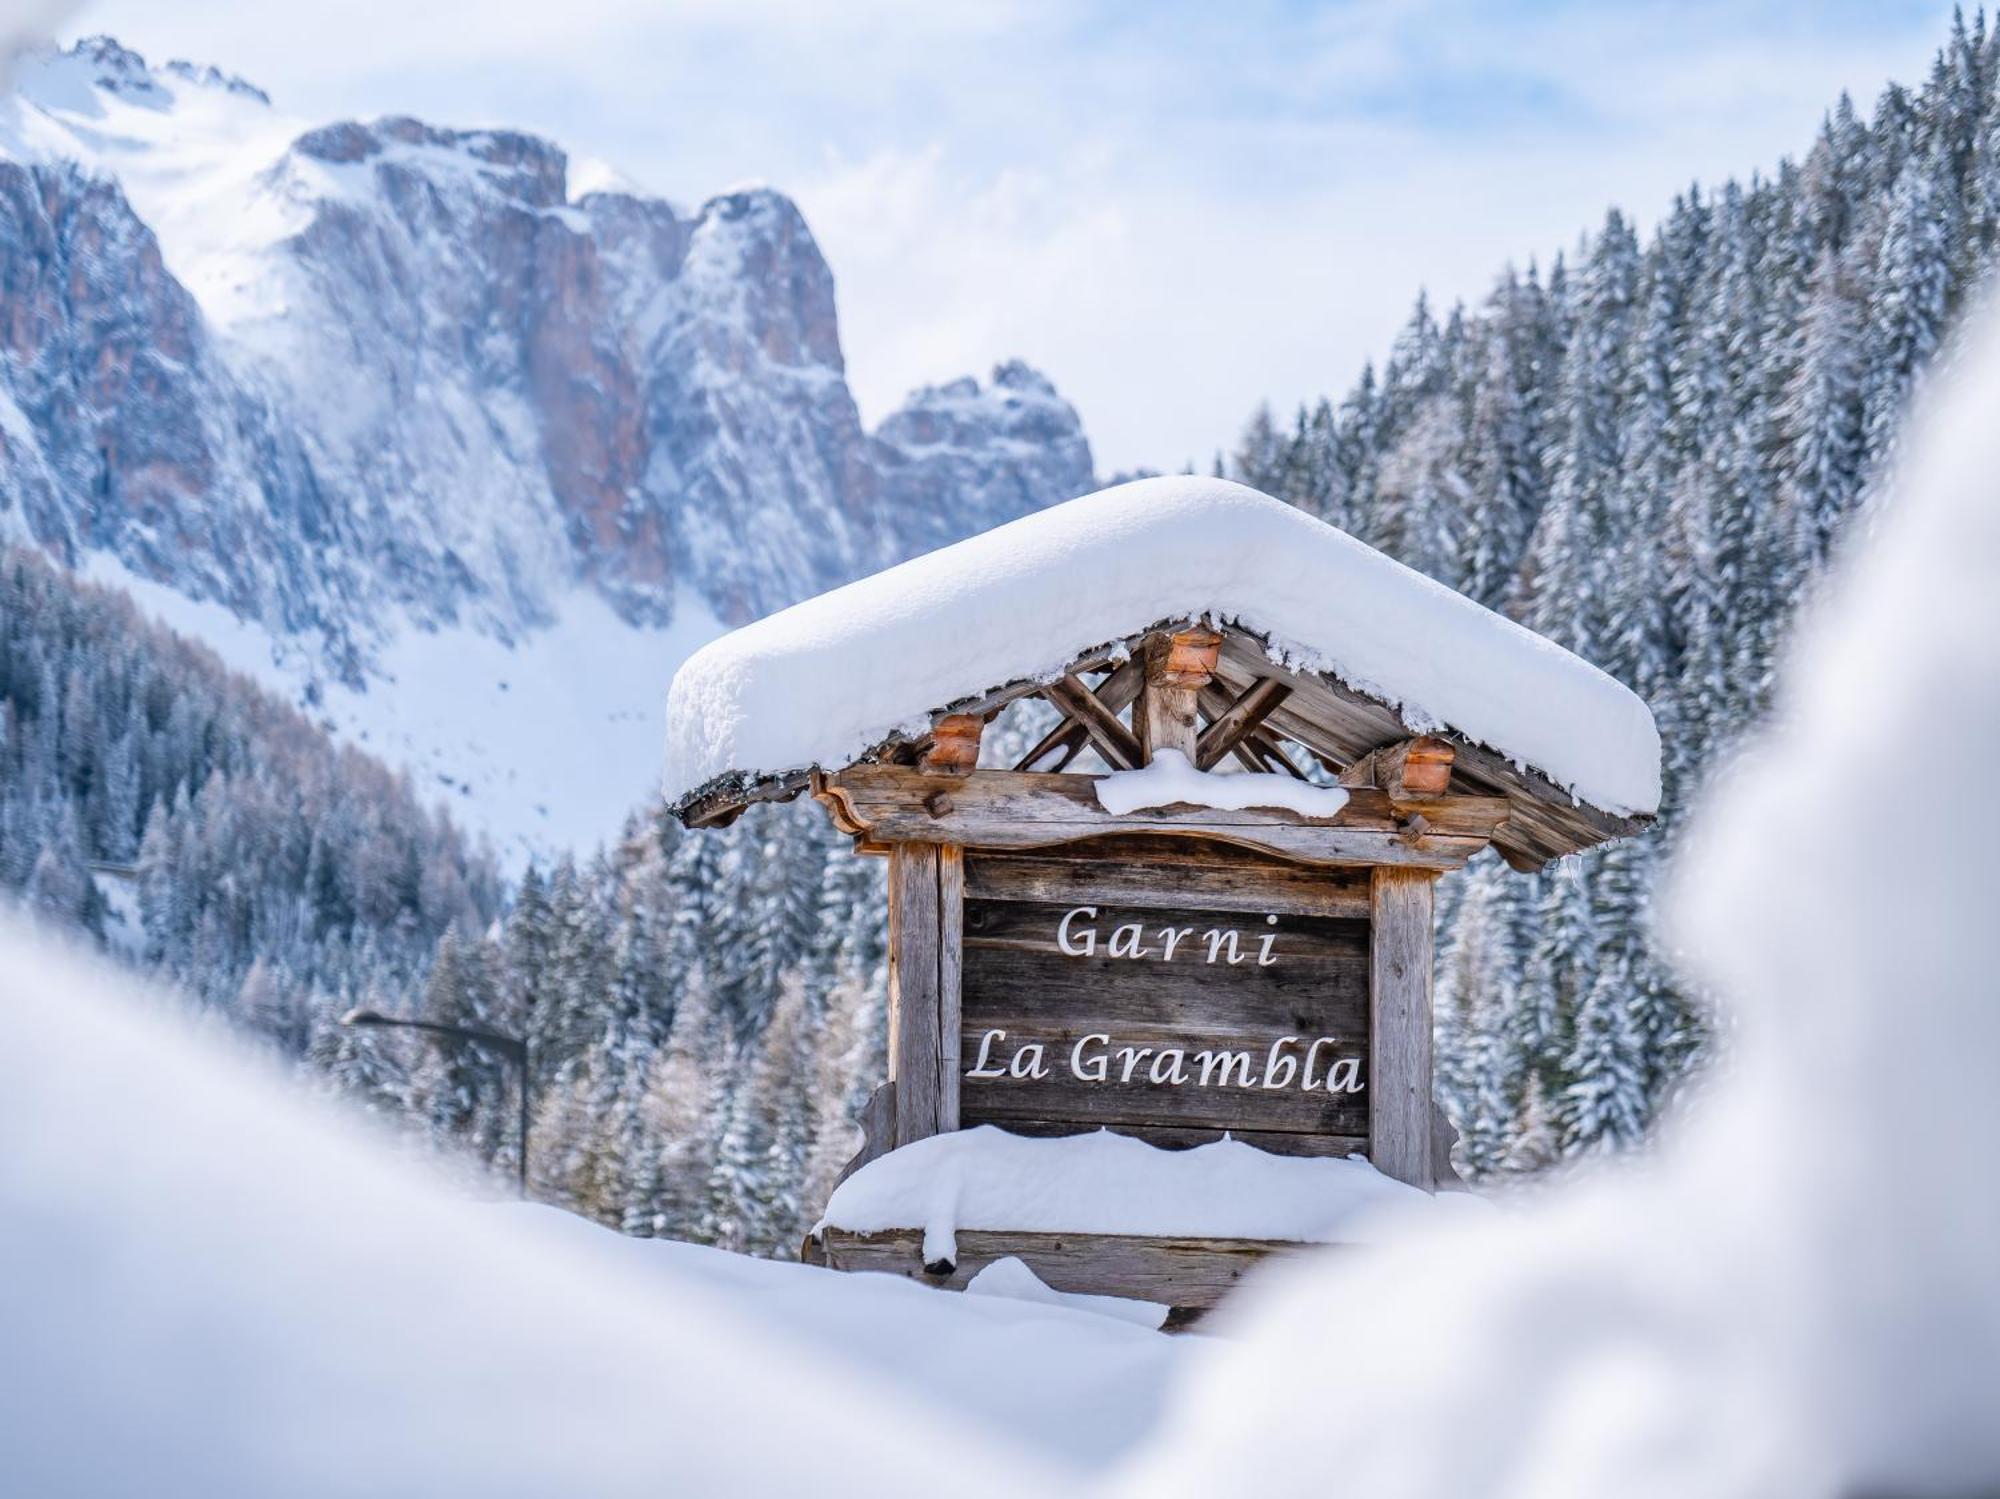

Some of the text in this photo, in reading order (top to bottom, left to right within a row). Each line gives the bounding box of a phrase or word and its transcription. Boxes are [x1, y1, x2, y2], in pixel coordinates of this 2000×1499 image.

[1057, 906, 1279, 966] Garni
[965, 1029, 1366, 1094] La Grambla
